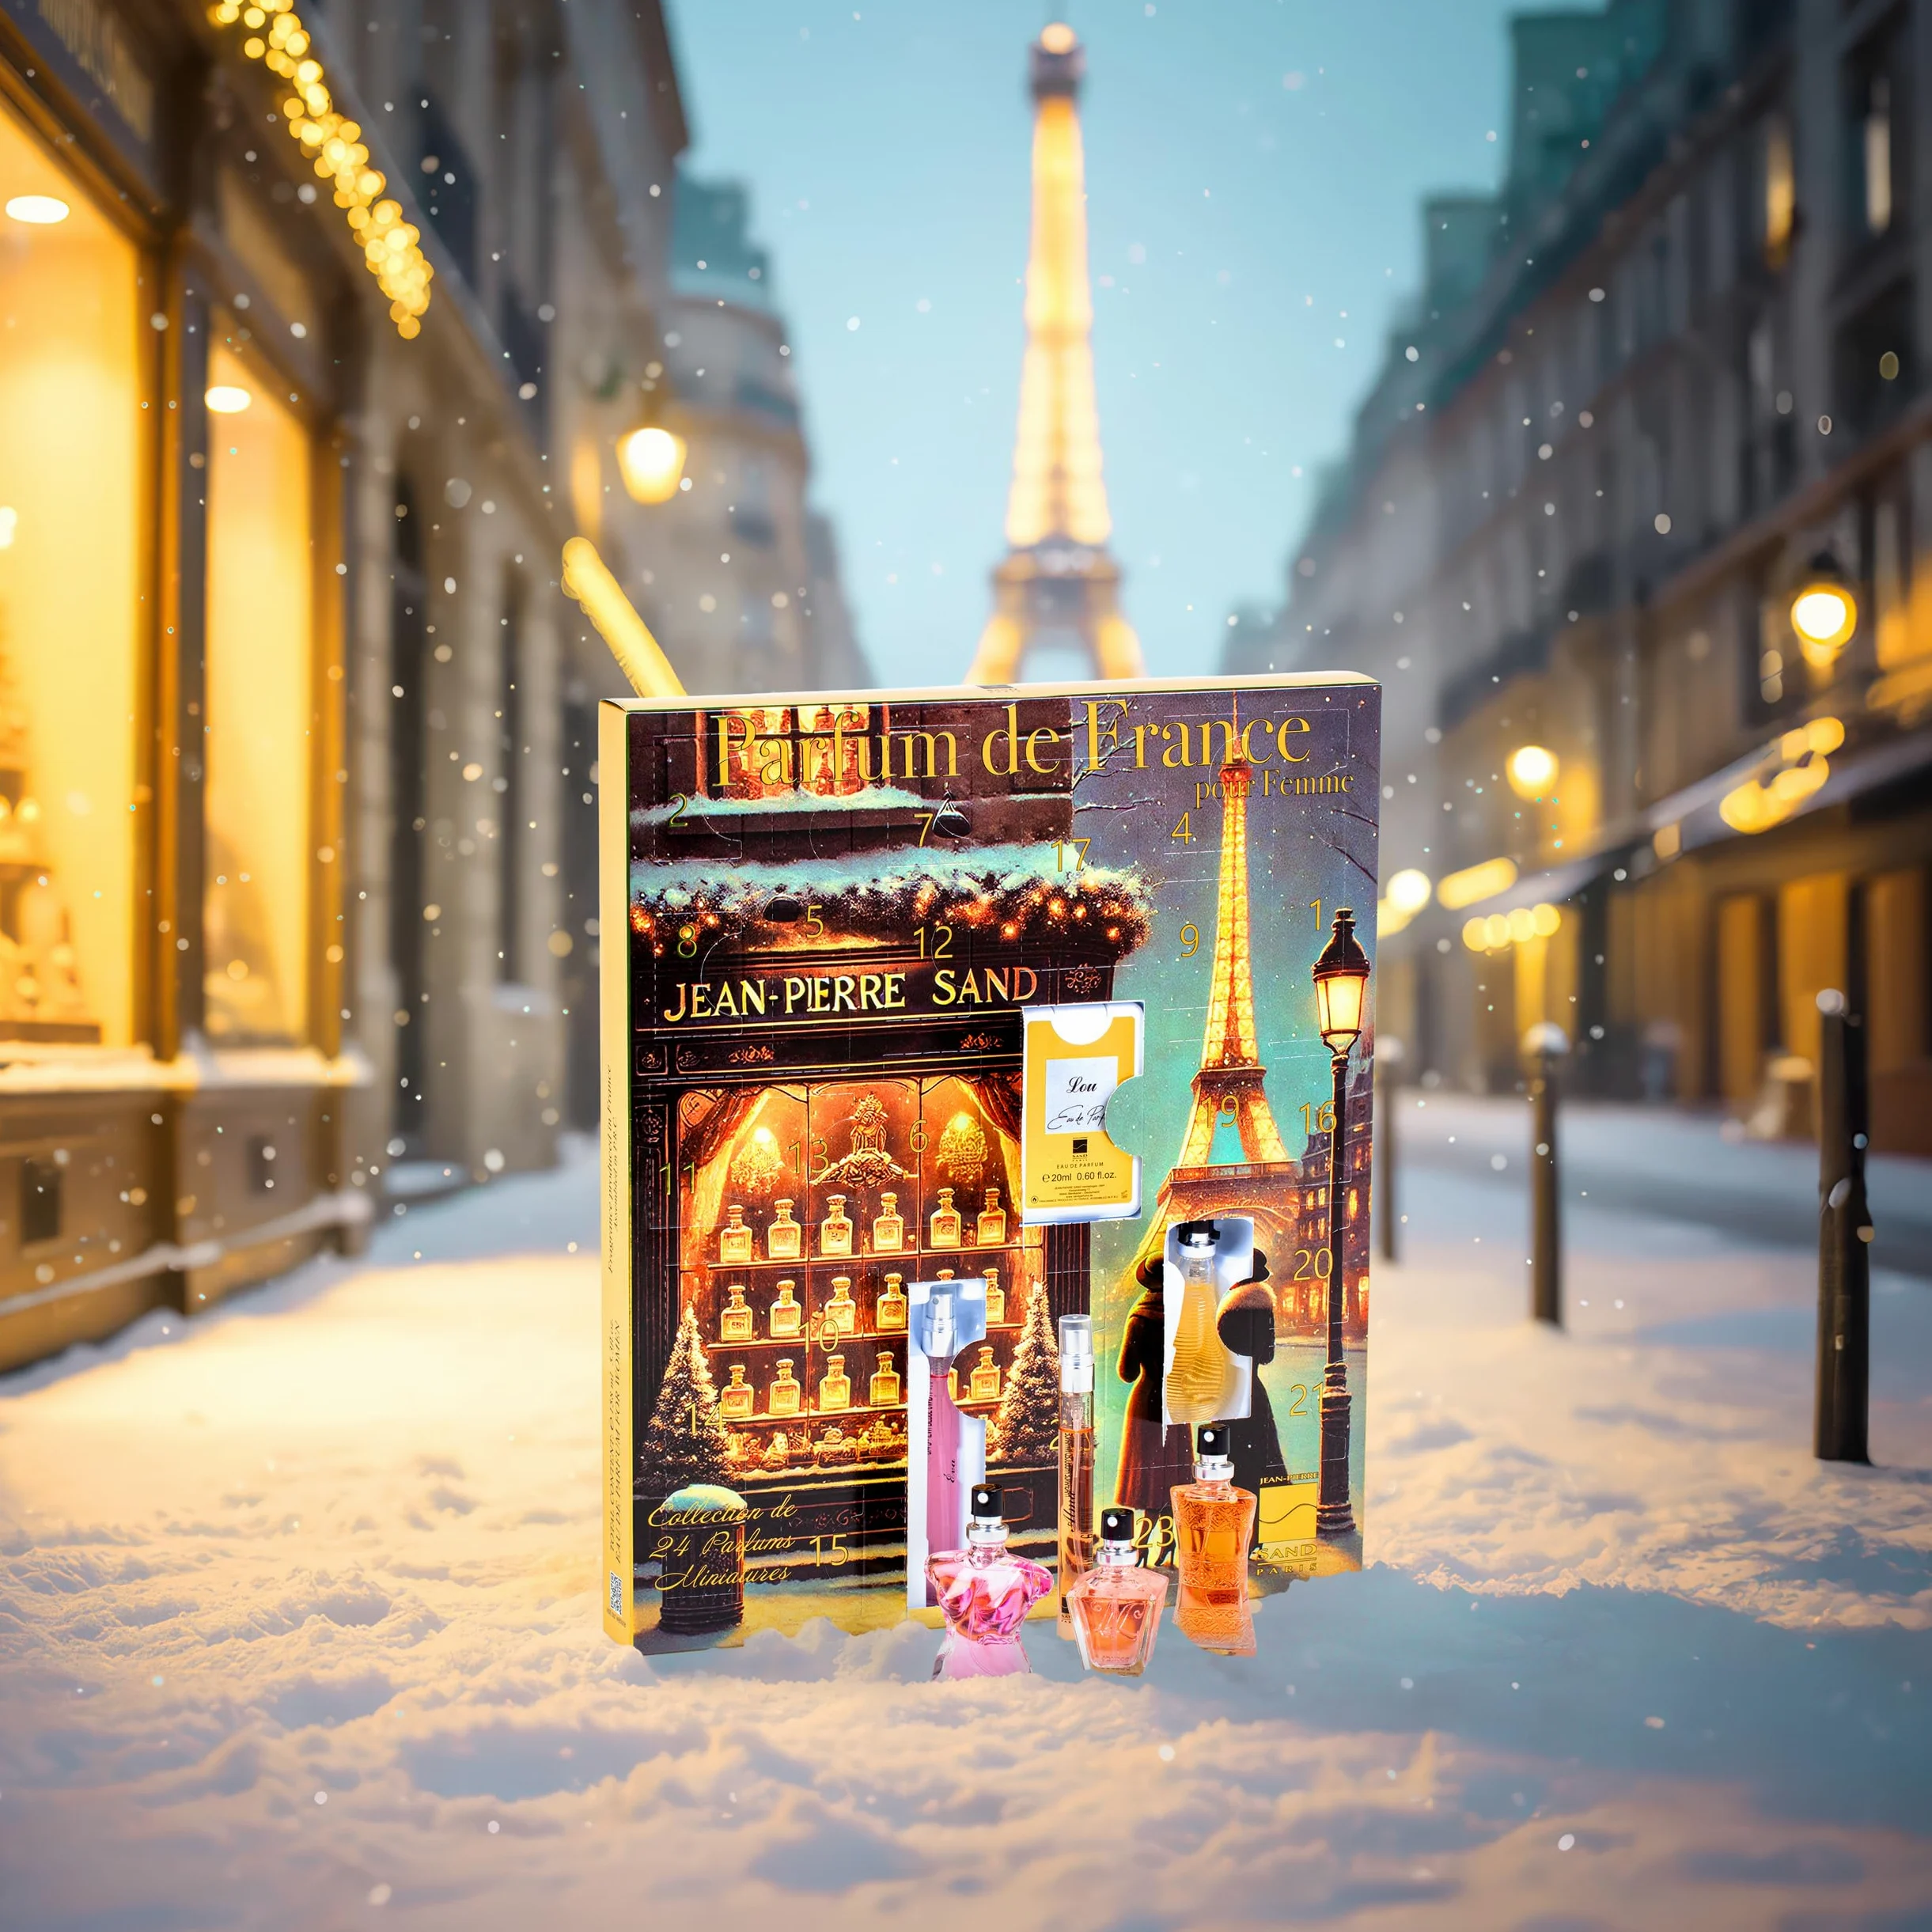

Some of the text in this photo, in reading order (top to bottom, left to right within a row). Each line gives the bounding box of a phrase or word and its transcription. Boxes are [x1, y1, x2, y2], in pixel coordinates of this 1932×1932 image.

[710, 698, 1311, 787] Parfum de France
[1194, 769, 1354, 809] pour Femme
[669, 792, 688, 828] 2
[913, 813, 934, 847] 7
[1171, 812, 1193, 845] 4
[1050, 837, 1092, 873] 17
[805, 904, 824, 939] 5
[1309, 898, 1322, 930] 1
[676, 924, 698, 959] 8
[912, 926, 953, 960] 12
[1180, 924, 1200, 958] 9
[663, 966, 1039, 1022] JEAN-PIERRE SAND
[1066, 1076, 1097, 1093] Lou
[1201, 1094, 1239, 1128] 19
[1299, 1100, 1337, 1135] 16
[909, 1119, 929, 1153] 6
[788, 1139, 829, 1174] 13
[659, 1161, 696, 1195] 11
[1077, 1172, 1095, 1180] 0.60
[1294, 1247, 1334, 1282] 20
[797, 1319, 840, 1353] 10
[1290, 1382, 1323, 1417] 21
[684, 1401, 726, 1435] 14
[1260, 1472, 1319, 1485] JEAN-PIERRE
[616, 1502, 621, 1525] DE
[648, 1494, 797, 1527] Collection de
[649, 1528, 796, 1562] 24 Parfums
[1135, 1515, 1174, 1549] 23
[809, 1533, 850, 1567] 15
[1257, 1544, 1317, 1560] SAND
[654, 1564, 792, 1591] Miniatures
[1256, 1563, 1317, 1576] PARIS
